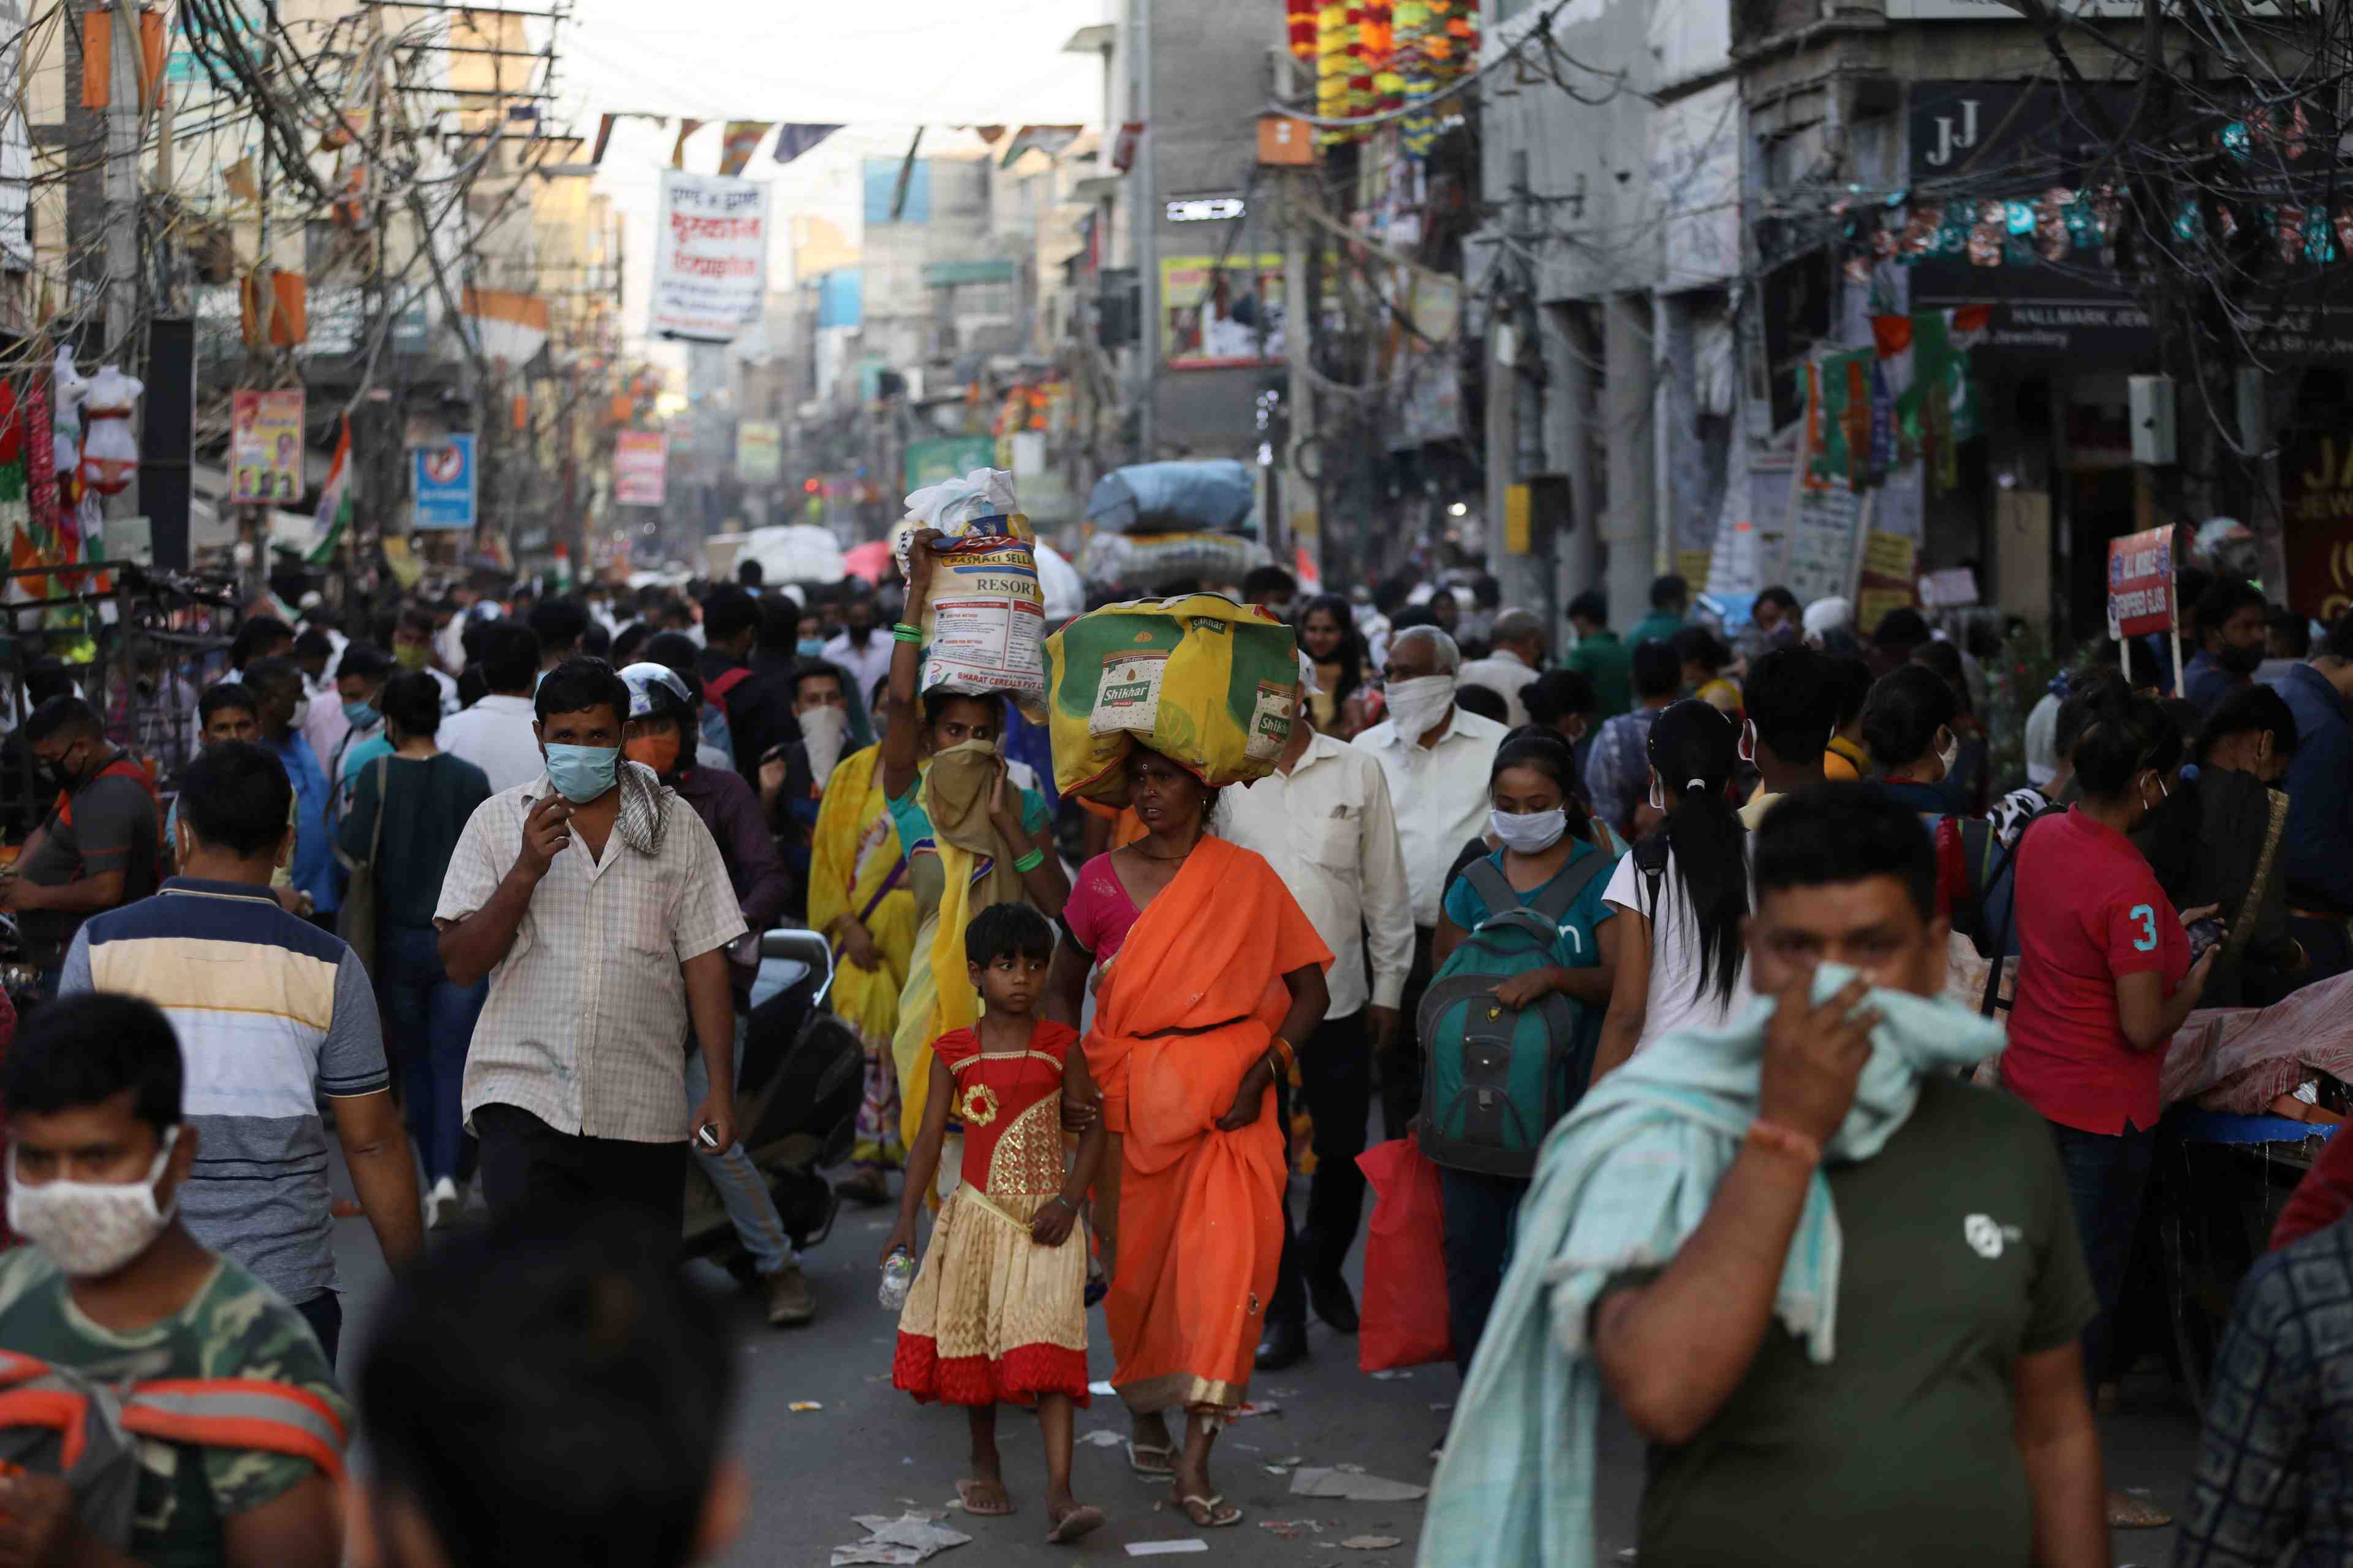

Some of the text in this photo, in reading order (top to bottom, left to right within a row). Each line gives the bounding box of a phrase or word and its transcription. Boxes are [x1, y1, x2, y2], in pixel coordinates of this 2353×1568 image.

[958, 672, 988, 684] BHARAT
[990, 677, 1021, 687] CEREALS
[1104, 686, 1147, 701] Shikhar
[2129, 904, 2157, 951] 3
